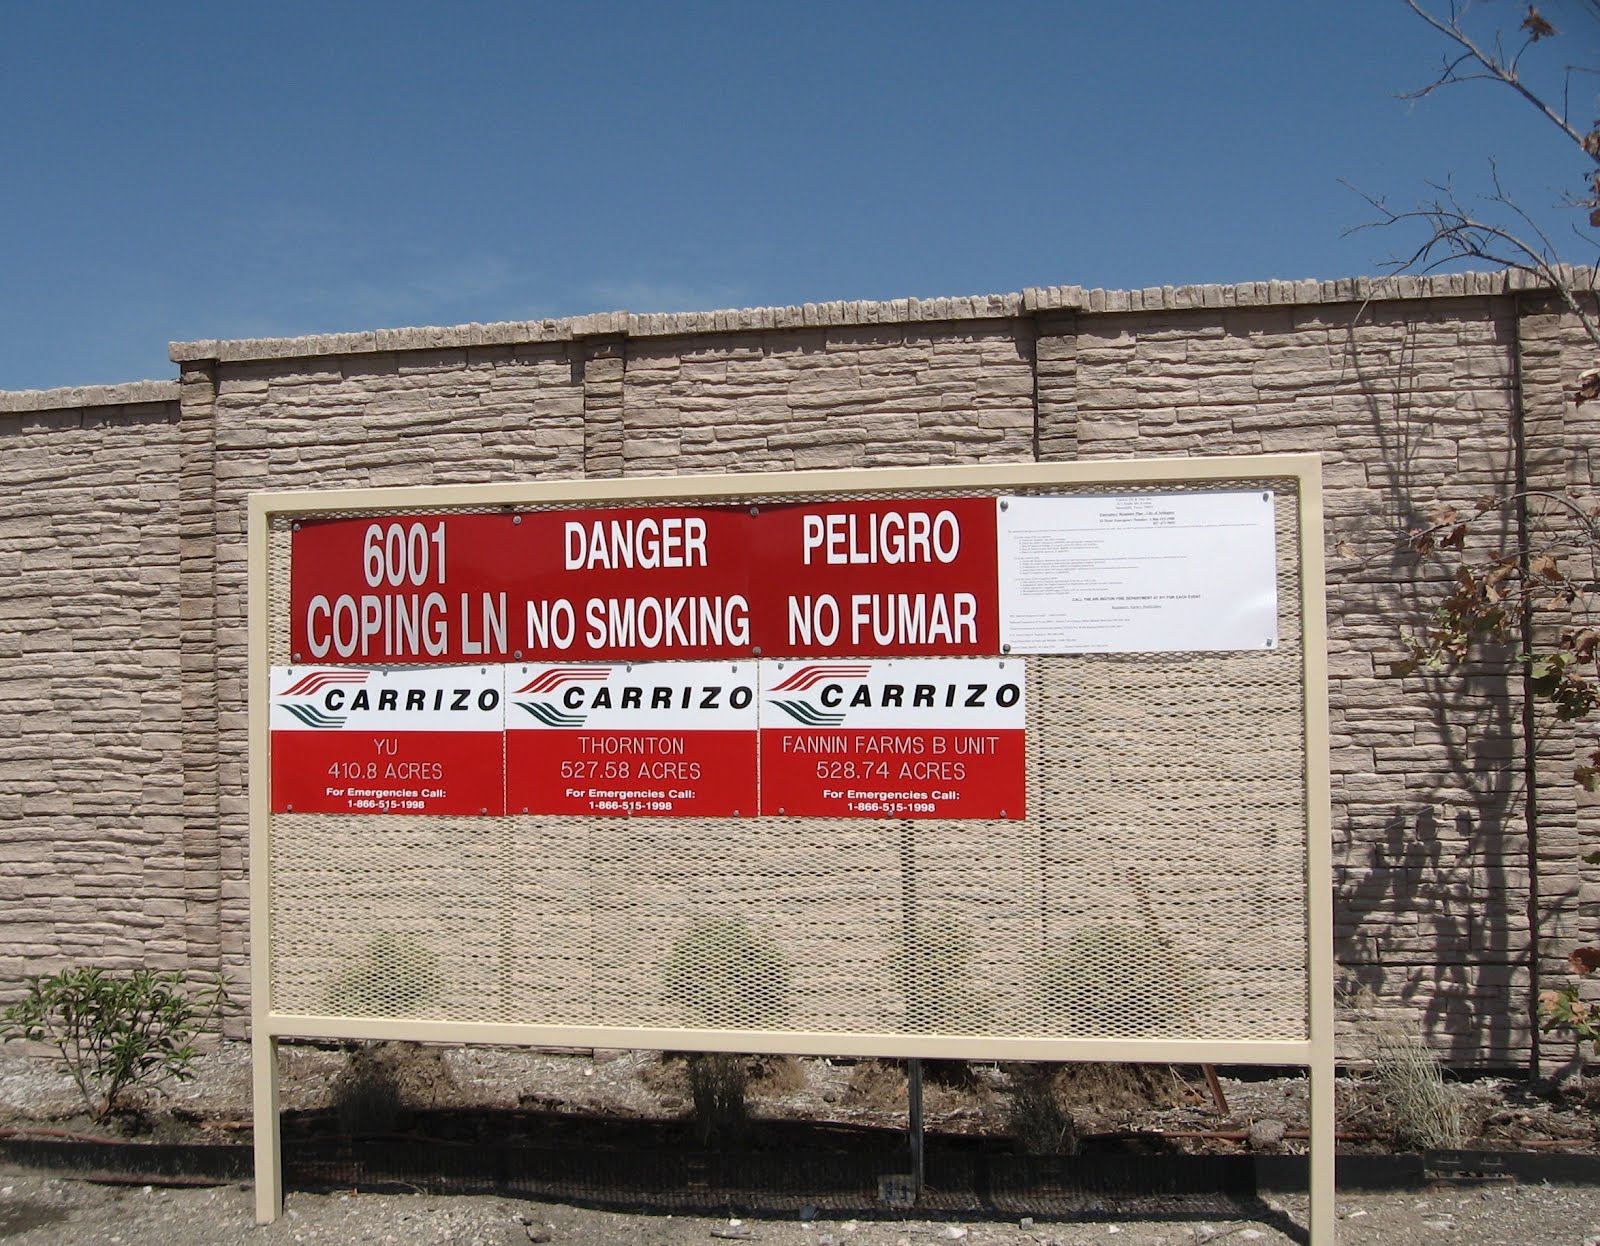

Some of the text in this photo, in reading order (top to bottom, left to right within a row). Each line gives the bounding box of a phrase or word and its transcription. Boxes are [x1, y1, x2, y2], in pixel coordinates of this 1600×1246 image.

[565, 517, 708, 570] DANGER
[803, 510, 960, 565] PELIGRO
[363, 521, 447, 588] 6001
[307, 592, 507, 658] COPING LN
[527, 594, 750, 650] NO SMOKING
[788, 592, 977, 646] NO FUMAR
[325, 689, 500, 711] CARRIZO
[563, 686, 753, 709] CARRIZO
[820, 683, 1021, 708] CARRIZO
[374, 738, 398, 755] YU
[578, 736, 684, 754] THORNTON
[783, 736, 999, 755] FANNIN FARMS B UNIT
[328, 762, 443, 780] 410.8 ACRES
[560, 761, 701, 780] 527.58 ACRES
[816, 761, 966, 781] 528.74 ACRES
[326, 787, 446, 800] For Emergencies Call:
[566, 788, 696, 801] For Emergencies Call:
[823, 789, 960, 802] For Emergencies Call:
[347, 799, 425, 809] 1-866-515-1998
[588, 801, 673, 811] 1-866-515-1998
[847, 802, 936, 813] 1-866-515-1998
